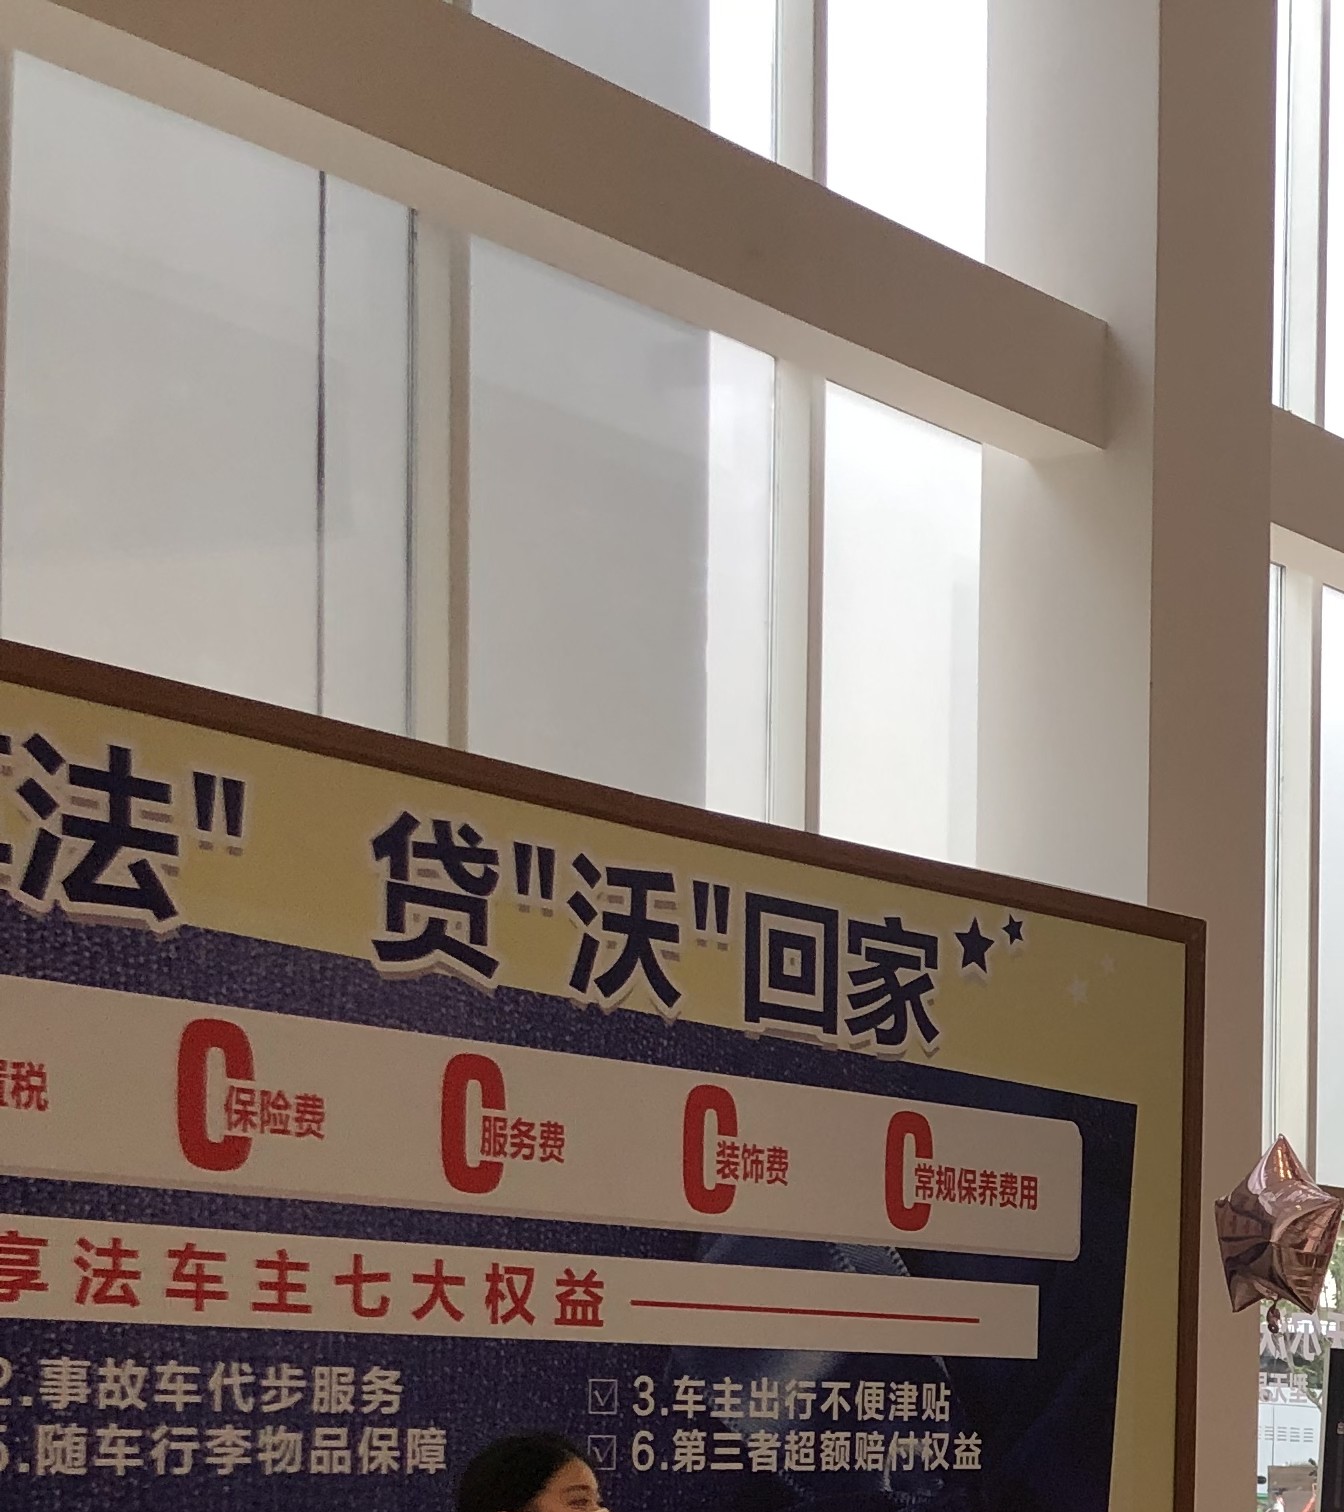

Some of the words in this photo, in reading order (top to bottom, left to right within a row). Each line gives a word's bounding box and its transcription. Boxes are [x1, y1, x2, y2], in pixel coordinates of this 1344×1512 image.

[0, 734, 246, 922] 法"
[371, 812, 939, 1046] 贷"沃"回家
[0, 1061, 48, 1111] 税
[223, 1086, 325, 1140] 保险费
[480, 1116, 565, 1165] 服务费
[716, 1141, 788, 1187] 装饰费
[915, 1164, 1038, 1211] 常规保养费用
[632, 1374, 951, 1423] 3.车主出行不便津贴
[631, 1429, 982, 1473] 6.第三者超额赔付权益
